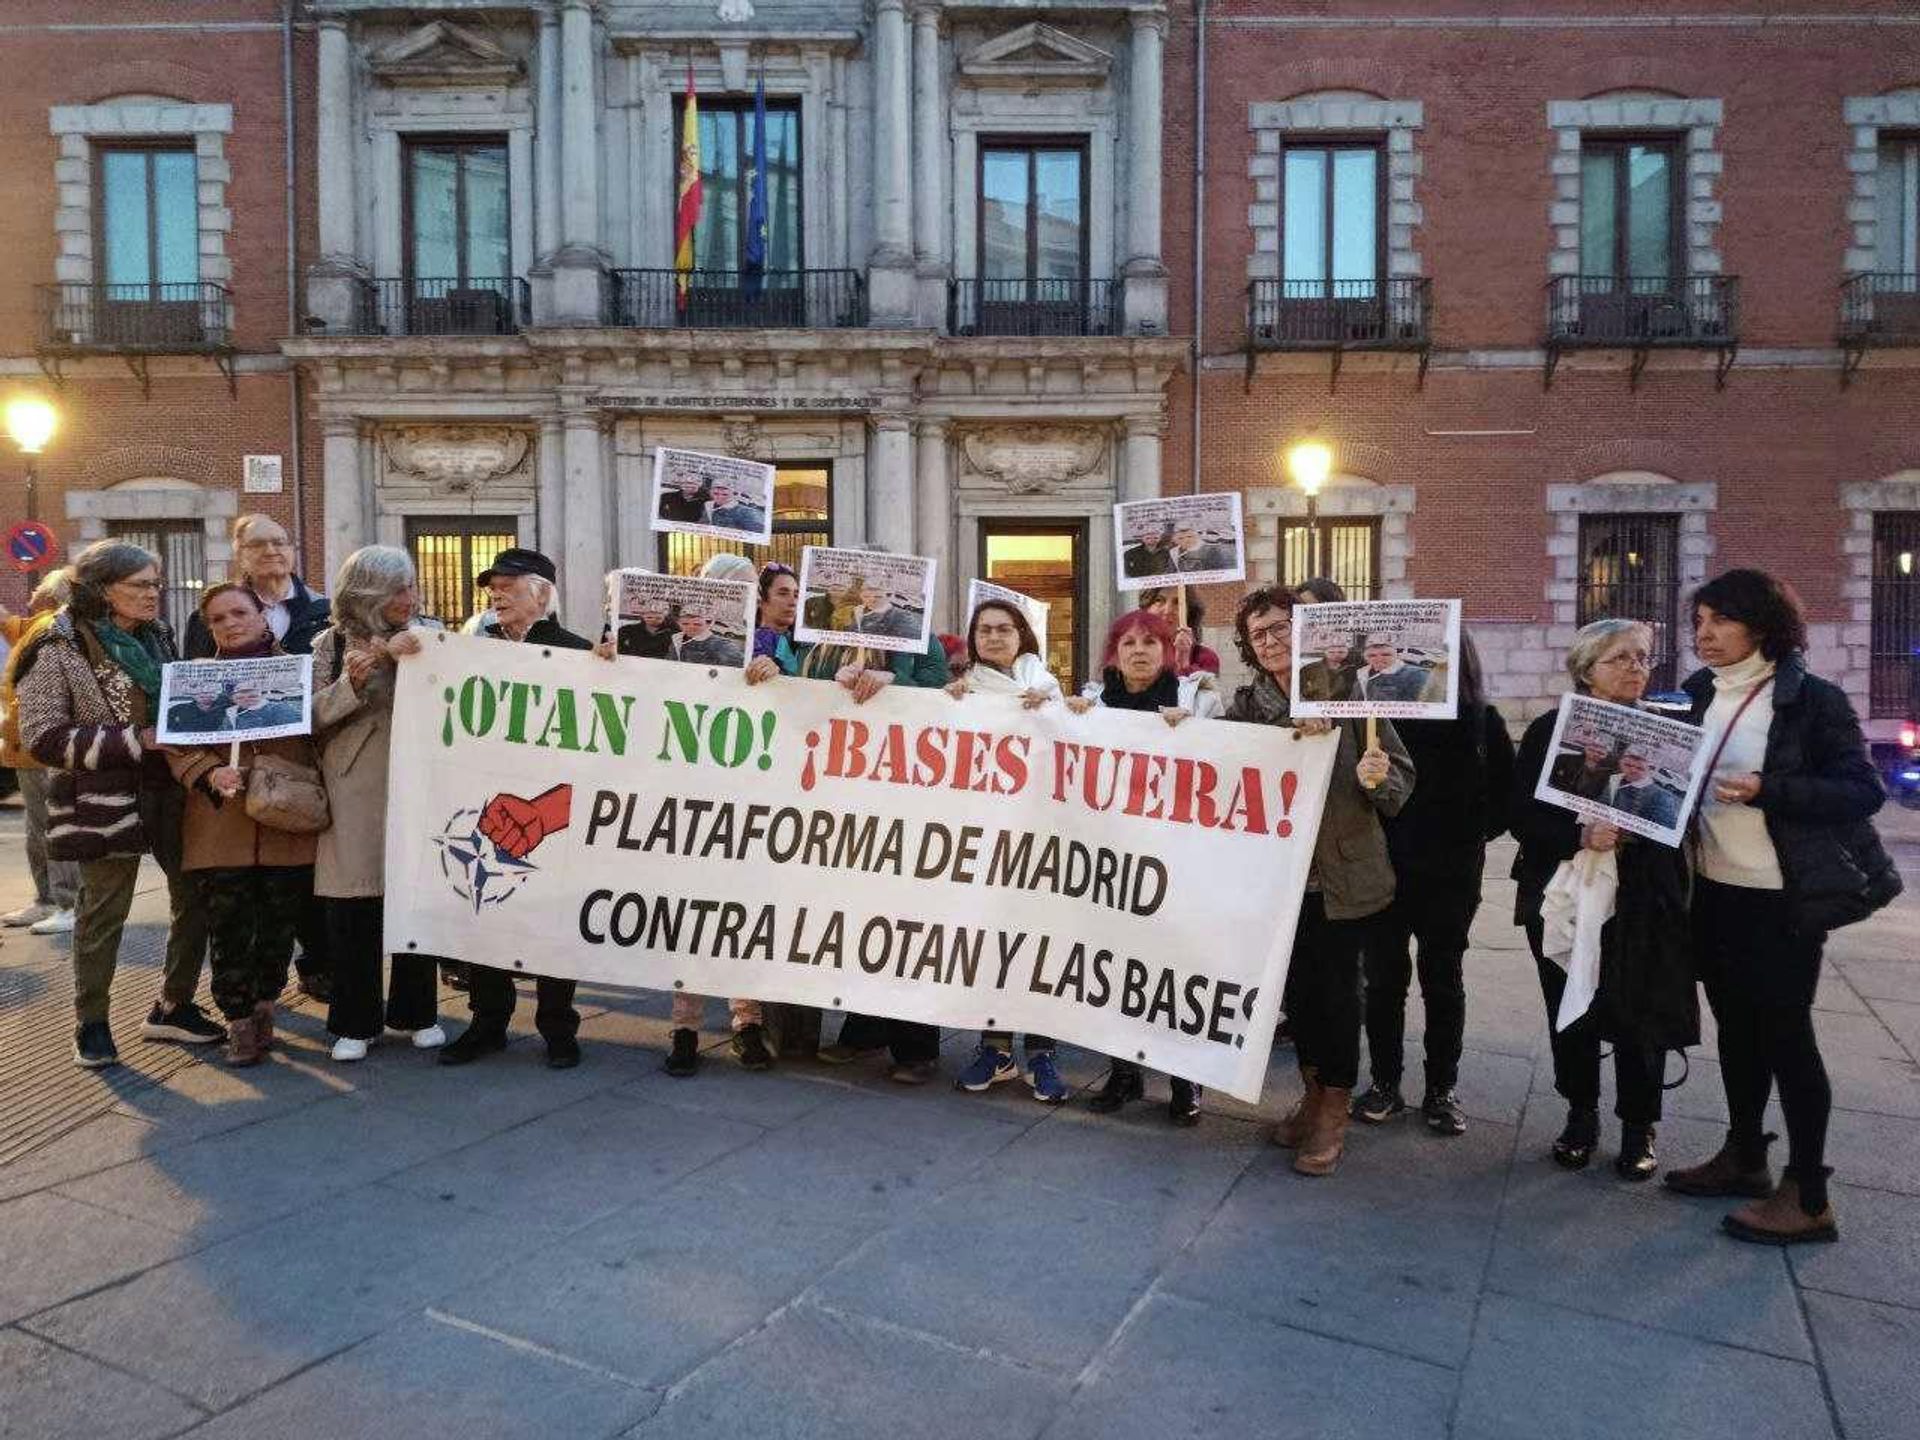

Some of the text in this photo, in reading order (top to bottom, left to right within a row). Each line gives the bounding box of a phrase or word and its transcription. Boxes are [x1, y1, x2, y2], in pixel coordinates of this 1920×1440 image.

[443, 675, 1298, 838] ¡OTAN NO! ¡BASES FUERA!
[585, 790, 1168, 916] PLATAFORMA DE MADRID
[579, 889, 776, 961] CONTRA
[787, 907, 844, 969] LA
[858, 916, 986, 988] OTAN
[996, 931, 1027, 990] Y
[1029, 935, 1114, 1008] LAS
